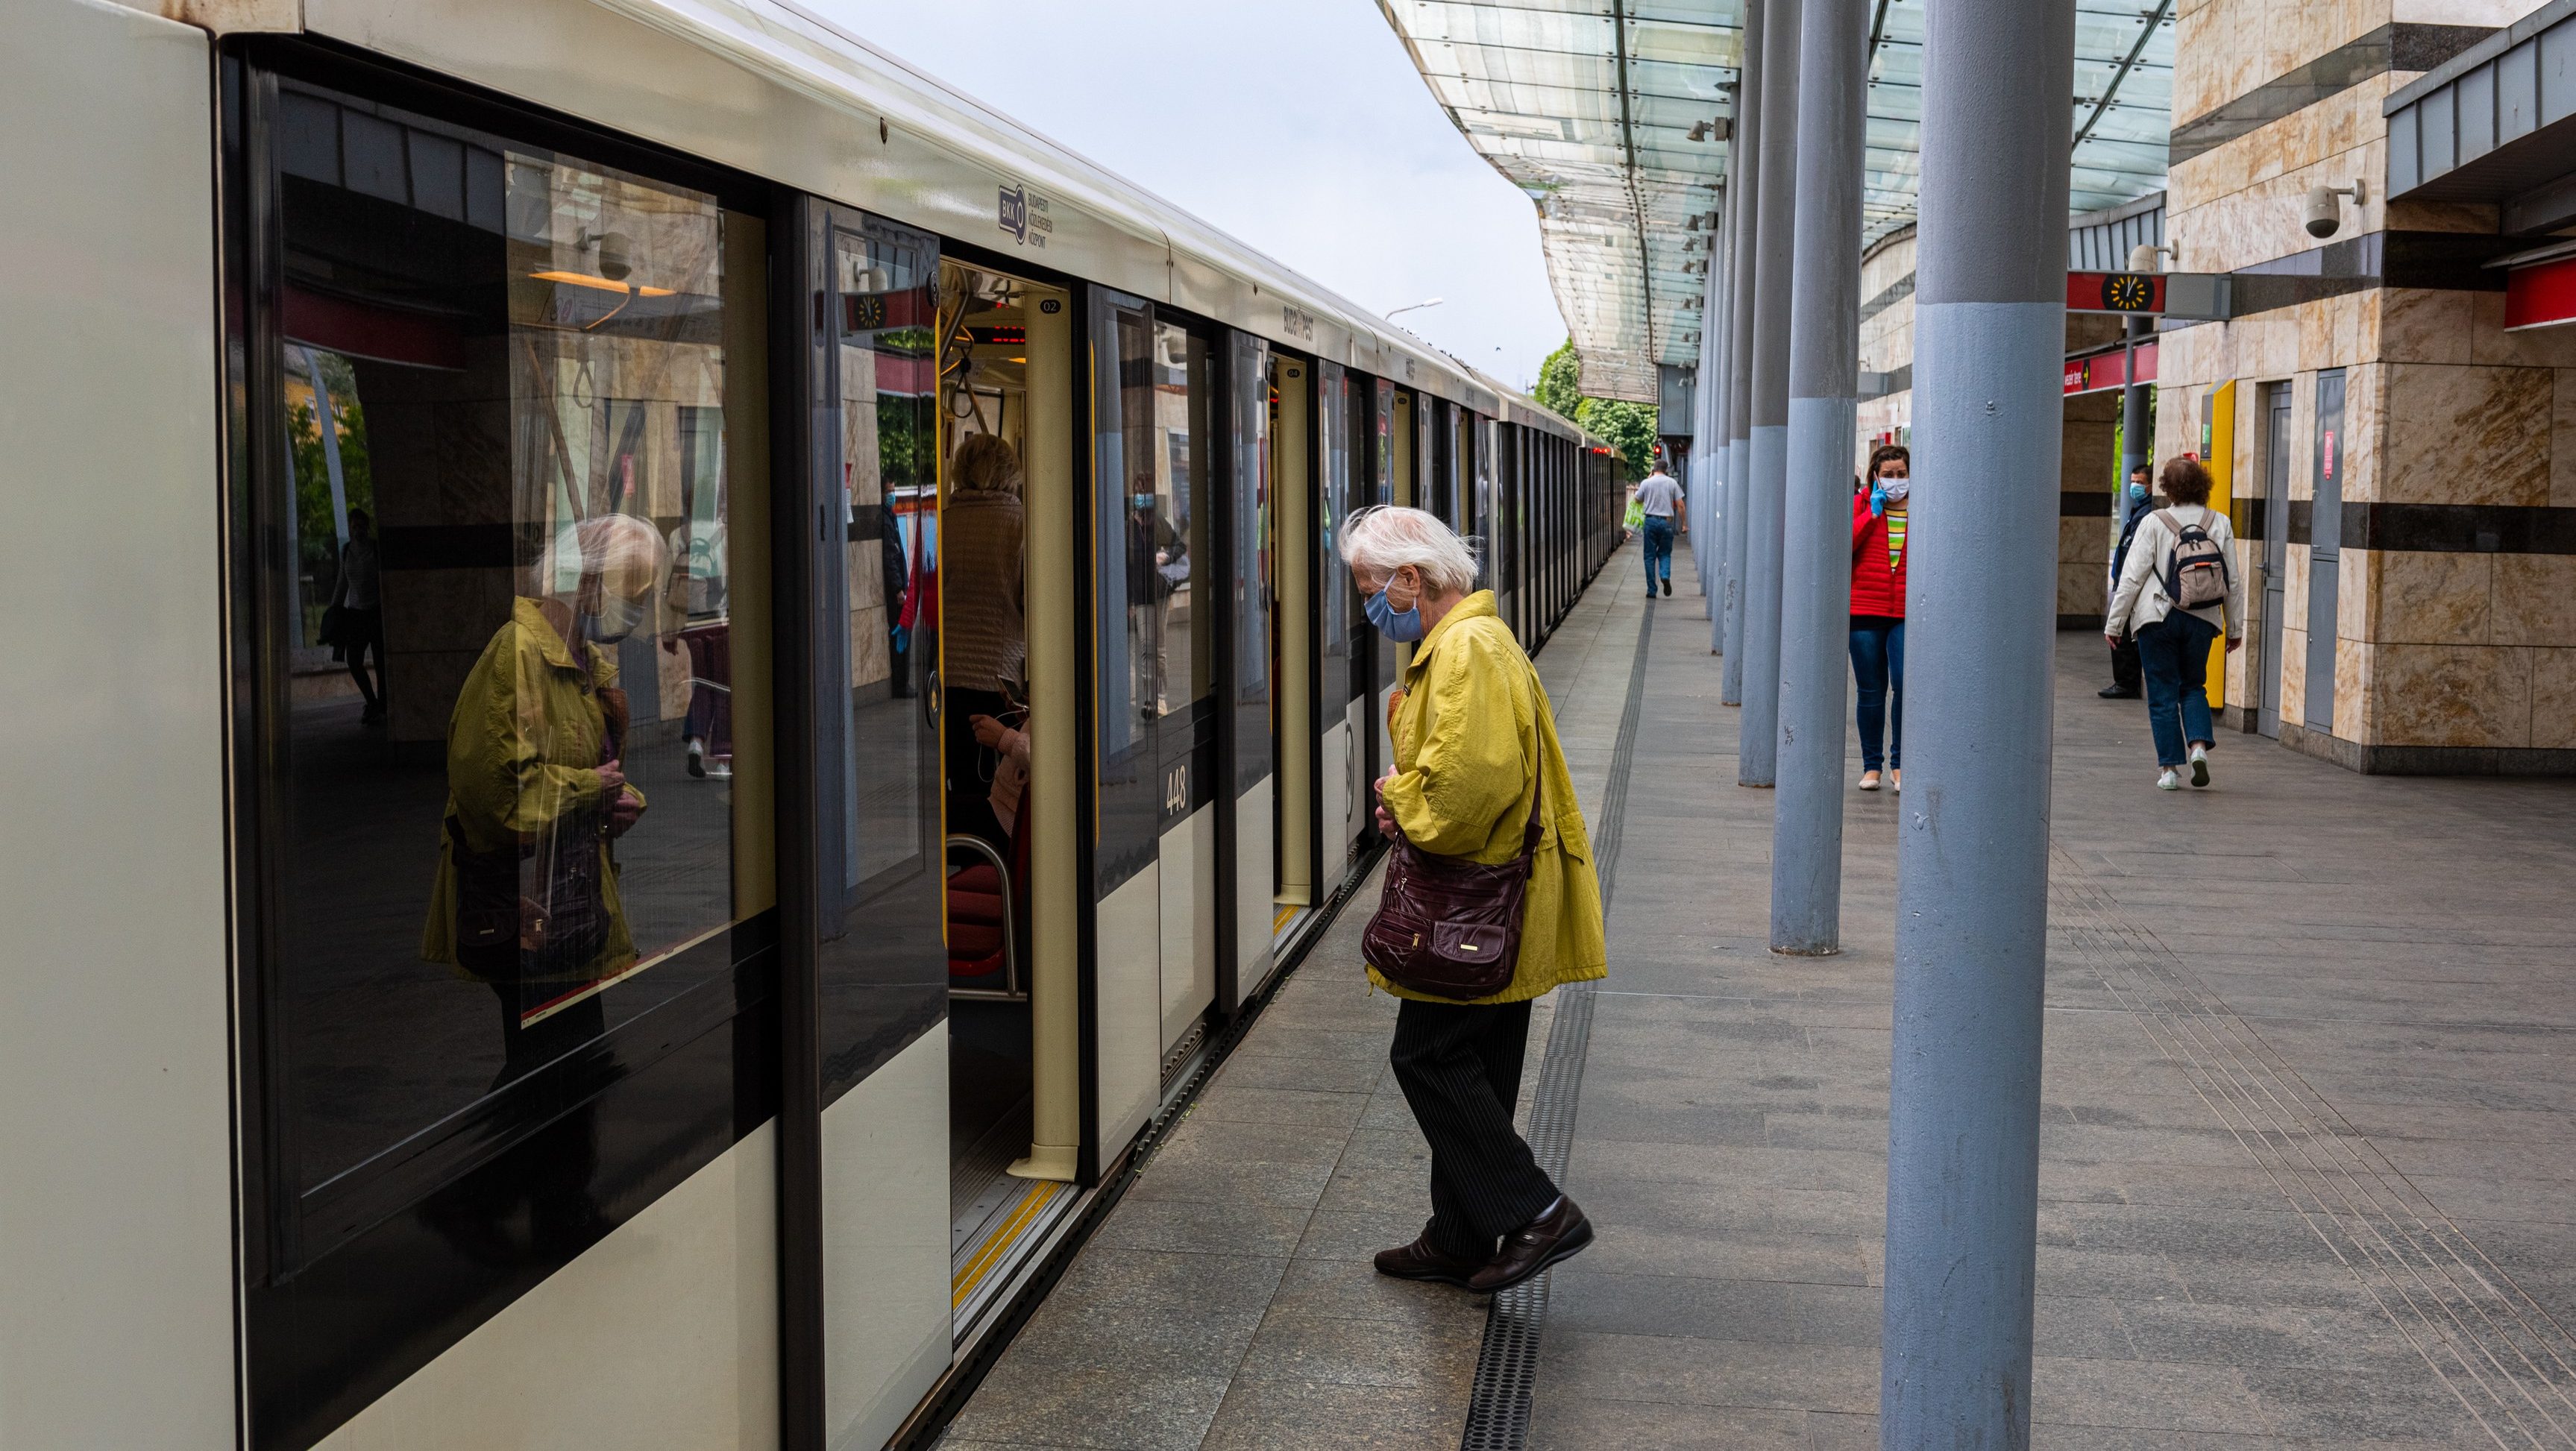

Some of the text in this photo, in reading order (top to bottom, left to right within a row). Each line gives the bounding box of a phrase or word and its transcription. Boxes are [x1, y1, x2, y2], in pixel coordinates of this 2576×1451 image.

[1002, 199, 1015, 221] BKK
[1028, 192, 1049, 213] BUDAPESTI
[1028, 228, 1046, 249] KÖZPONT
[1043, 302, 1057, 312] 02
[1166, 764, 1186, 816] 448
